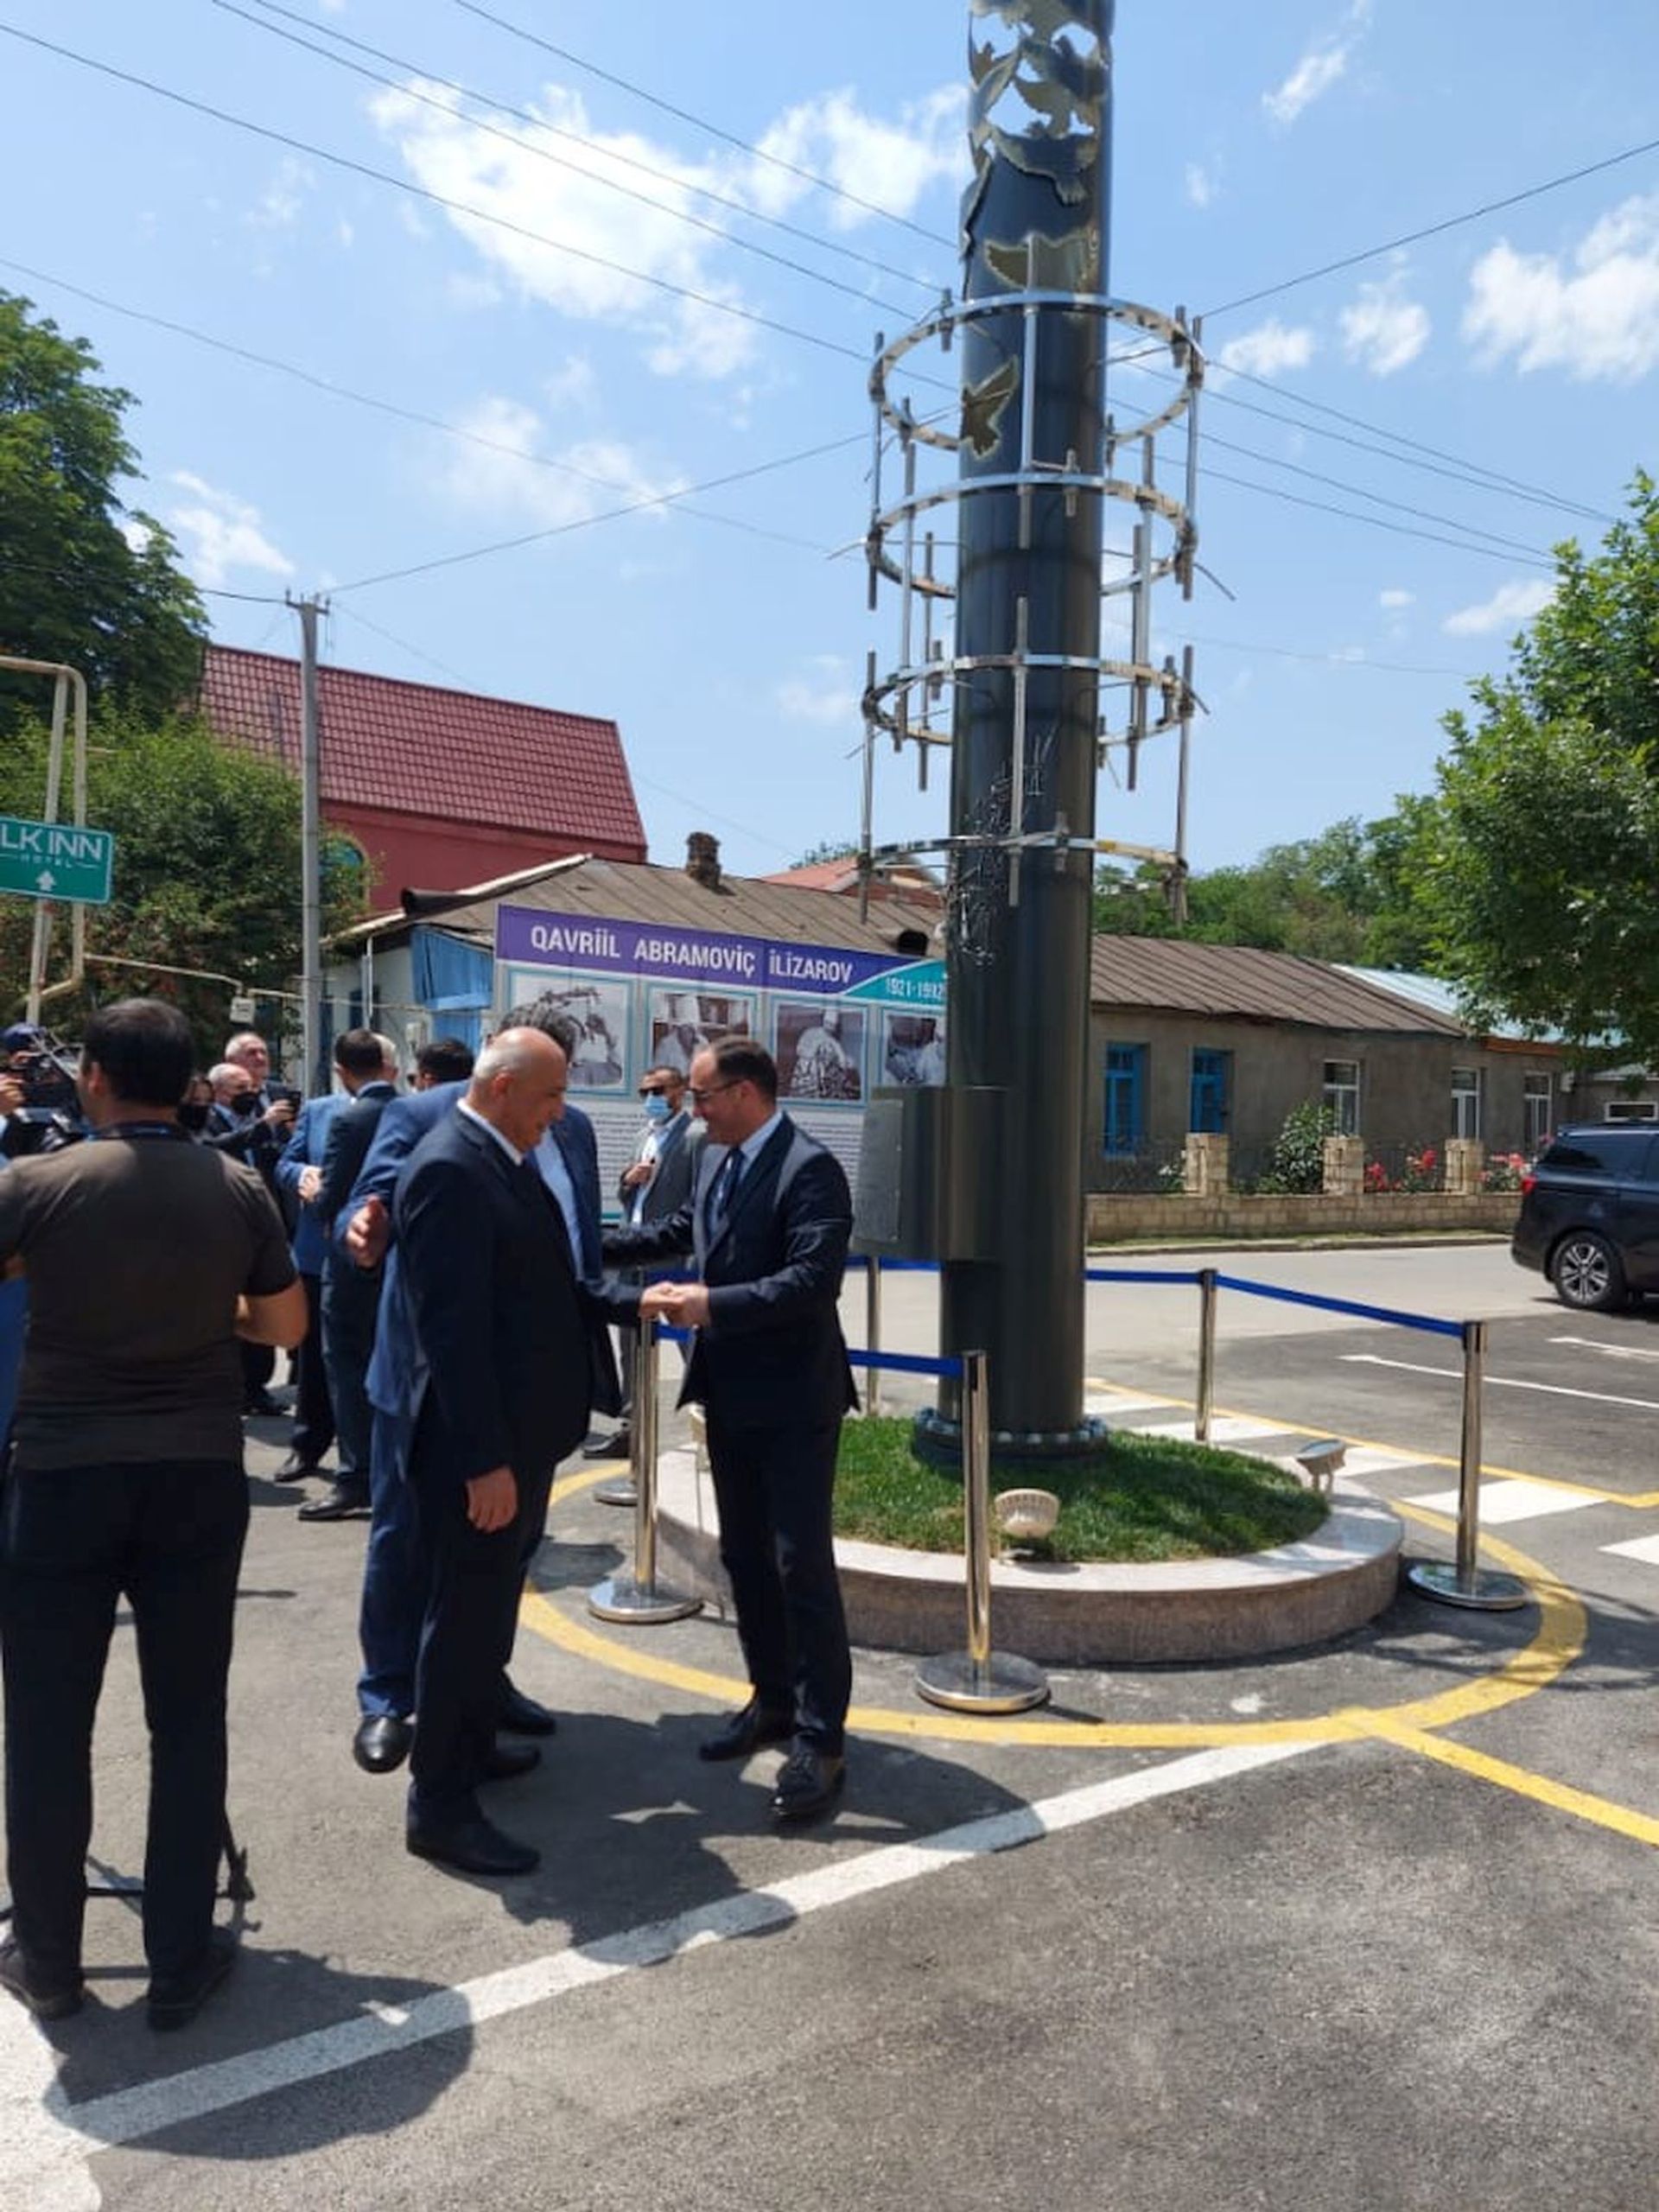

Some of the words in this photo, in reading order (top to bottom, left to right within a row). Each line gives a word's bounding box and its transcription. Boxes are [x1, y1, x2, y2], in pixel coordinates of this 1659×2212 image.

[48, 830, 102, 861] INN
[531, 925, 621, 958] QAVRİİL
[633, 938, 756, 979] ABRAMOVİÇ
[768, 948, 854, 983] İLİZAROV
